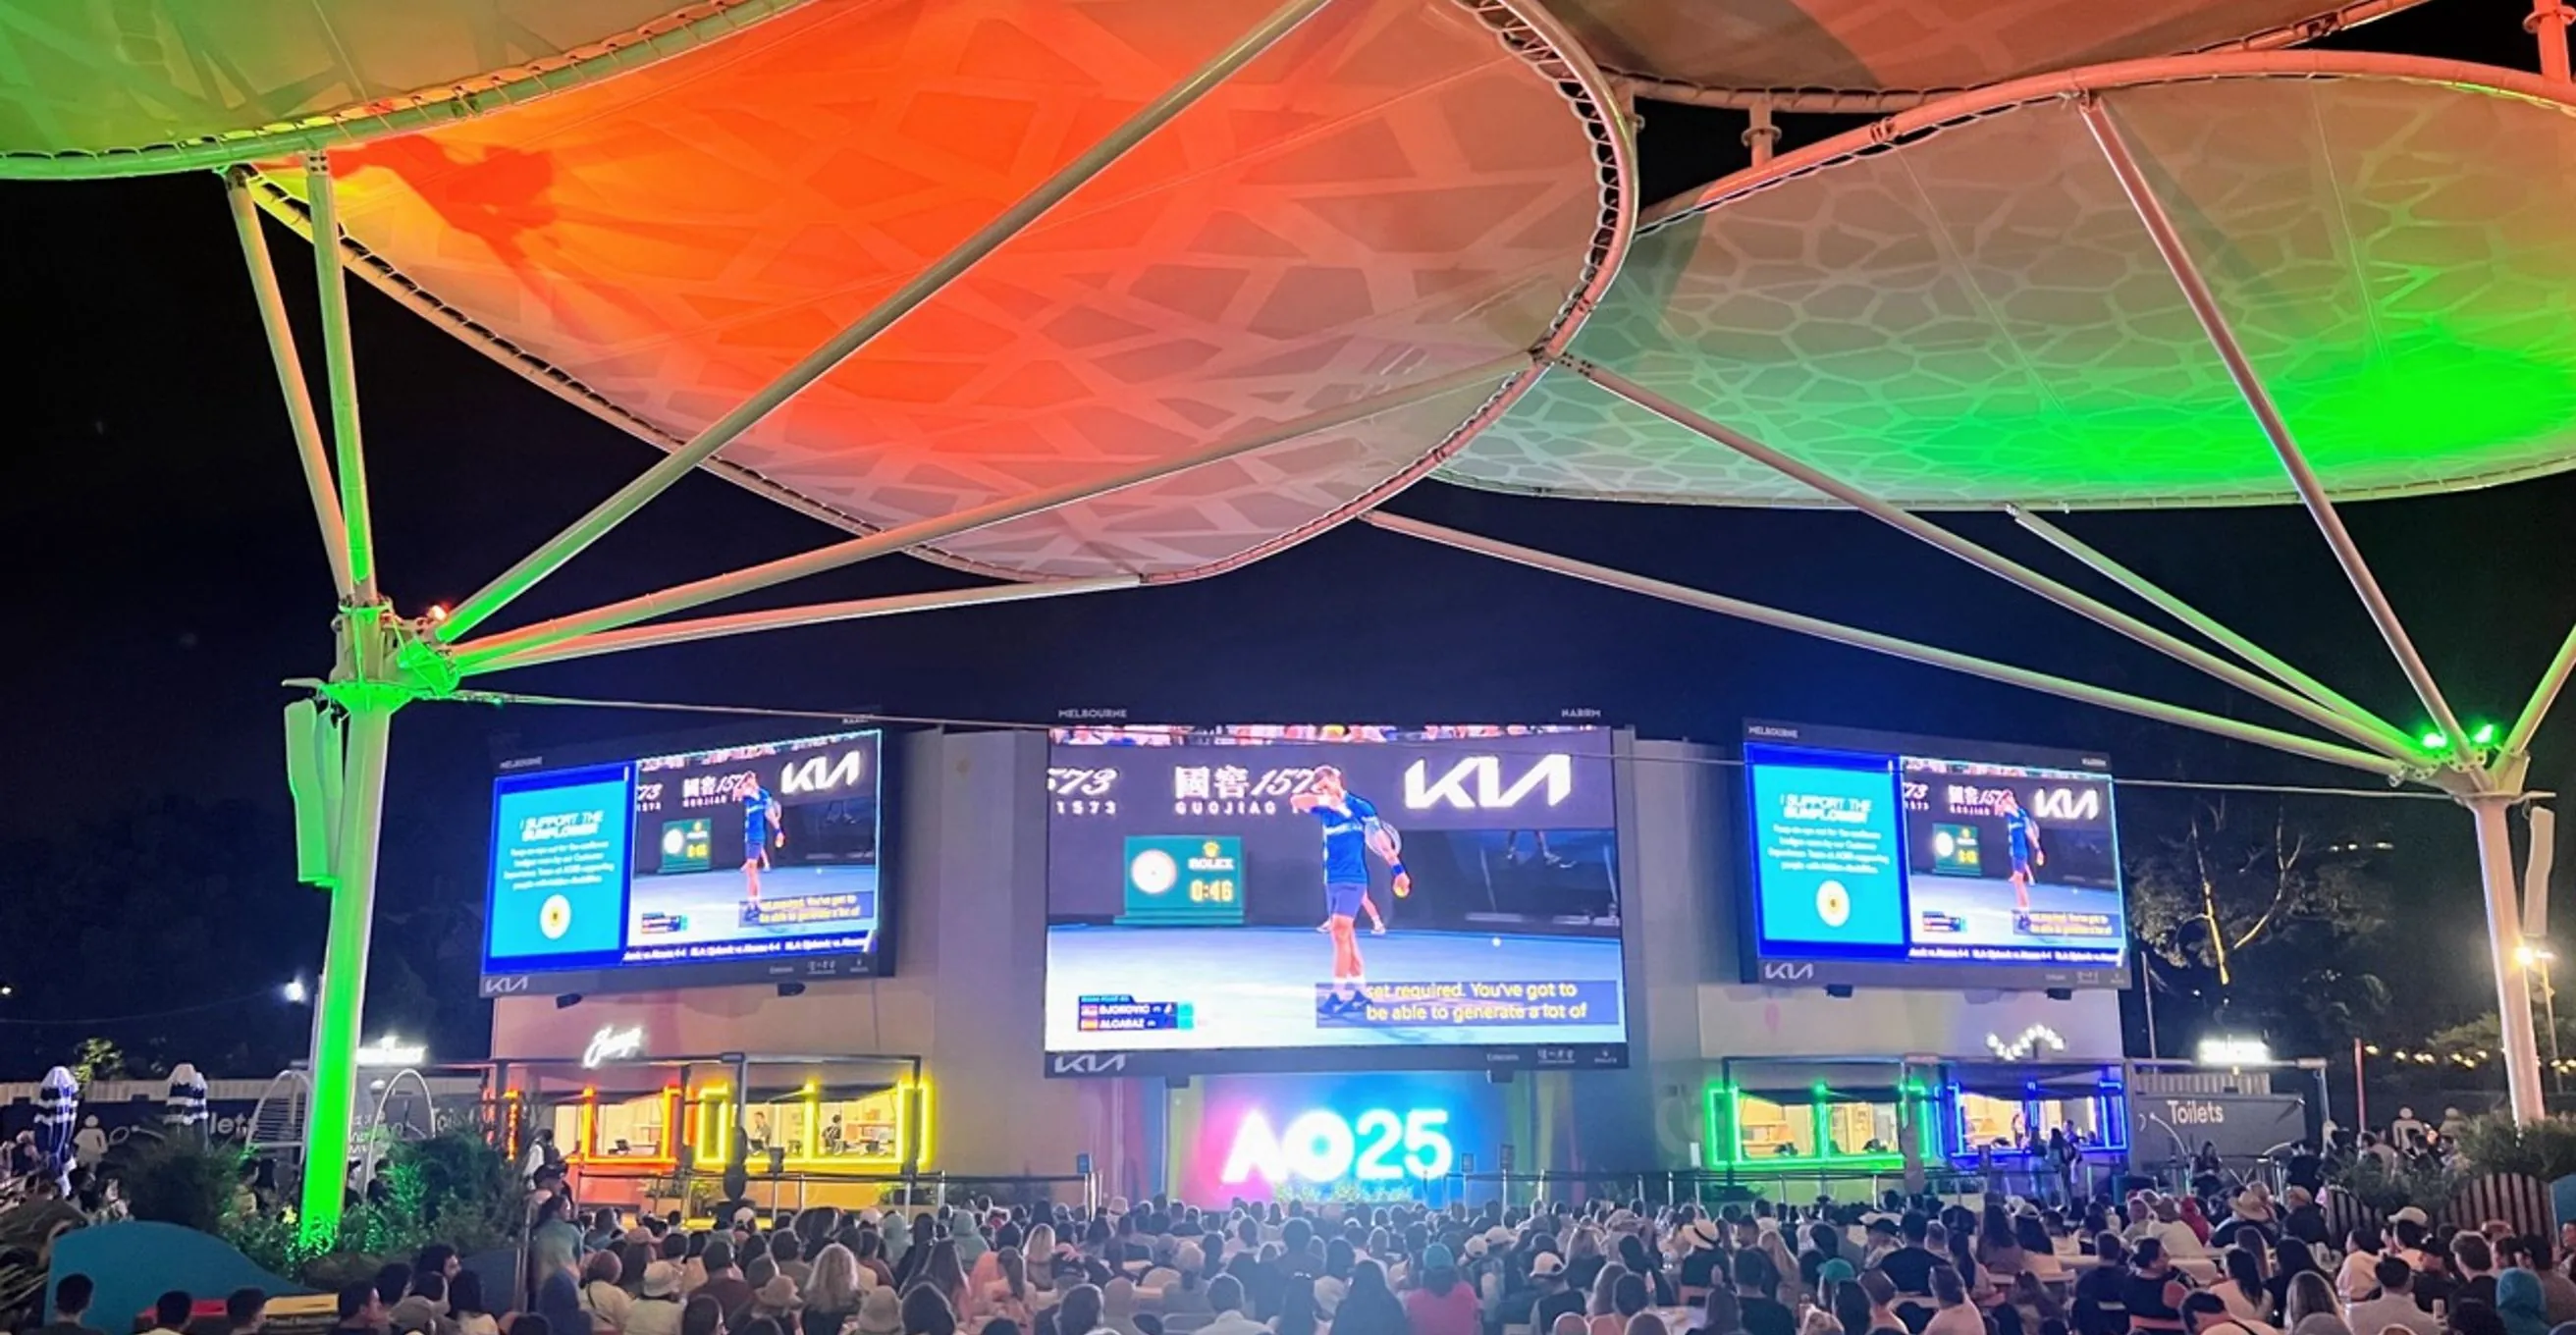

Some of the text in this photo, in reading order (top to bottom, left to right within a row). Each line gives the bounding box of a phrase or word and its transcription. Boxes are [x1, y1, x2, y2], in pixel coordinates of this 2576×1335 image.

[1058, 709, 1127, 719] MELBOURNE
[779, 750, 862, 795] KIA
[1405, 754, 1571, 809] KIA
[1175, 801, 1276, 815] GUOJIAO
[2032, 787, 2099, 821] KIA
[1190, 880, 1233, 902] 0:46
[1765, 962, 1814, 980] KIA
[485, 975, 528, 994] KIA
[1395, 982, 1467, 1001] required.
[1472, 983, 1524, 997] You've
[1527, 983, 1555, 1000] got
[1558, 983, 1578, 997] to
[1366, 1002, 1587, 1023] be able to generate a lot of
[1054, 1053, 1126, 1074] KIA
[2167, 1099, 2224, 1125] Toilets
[1220, 1108, 1453, 1183] AO25
